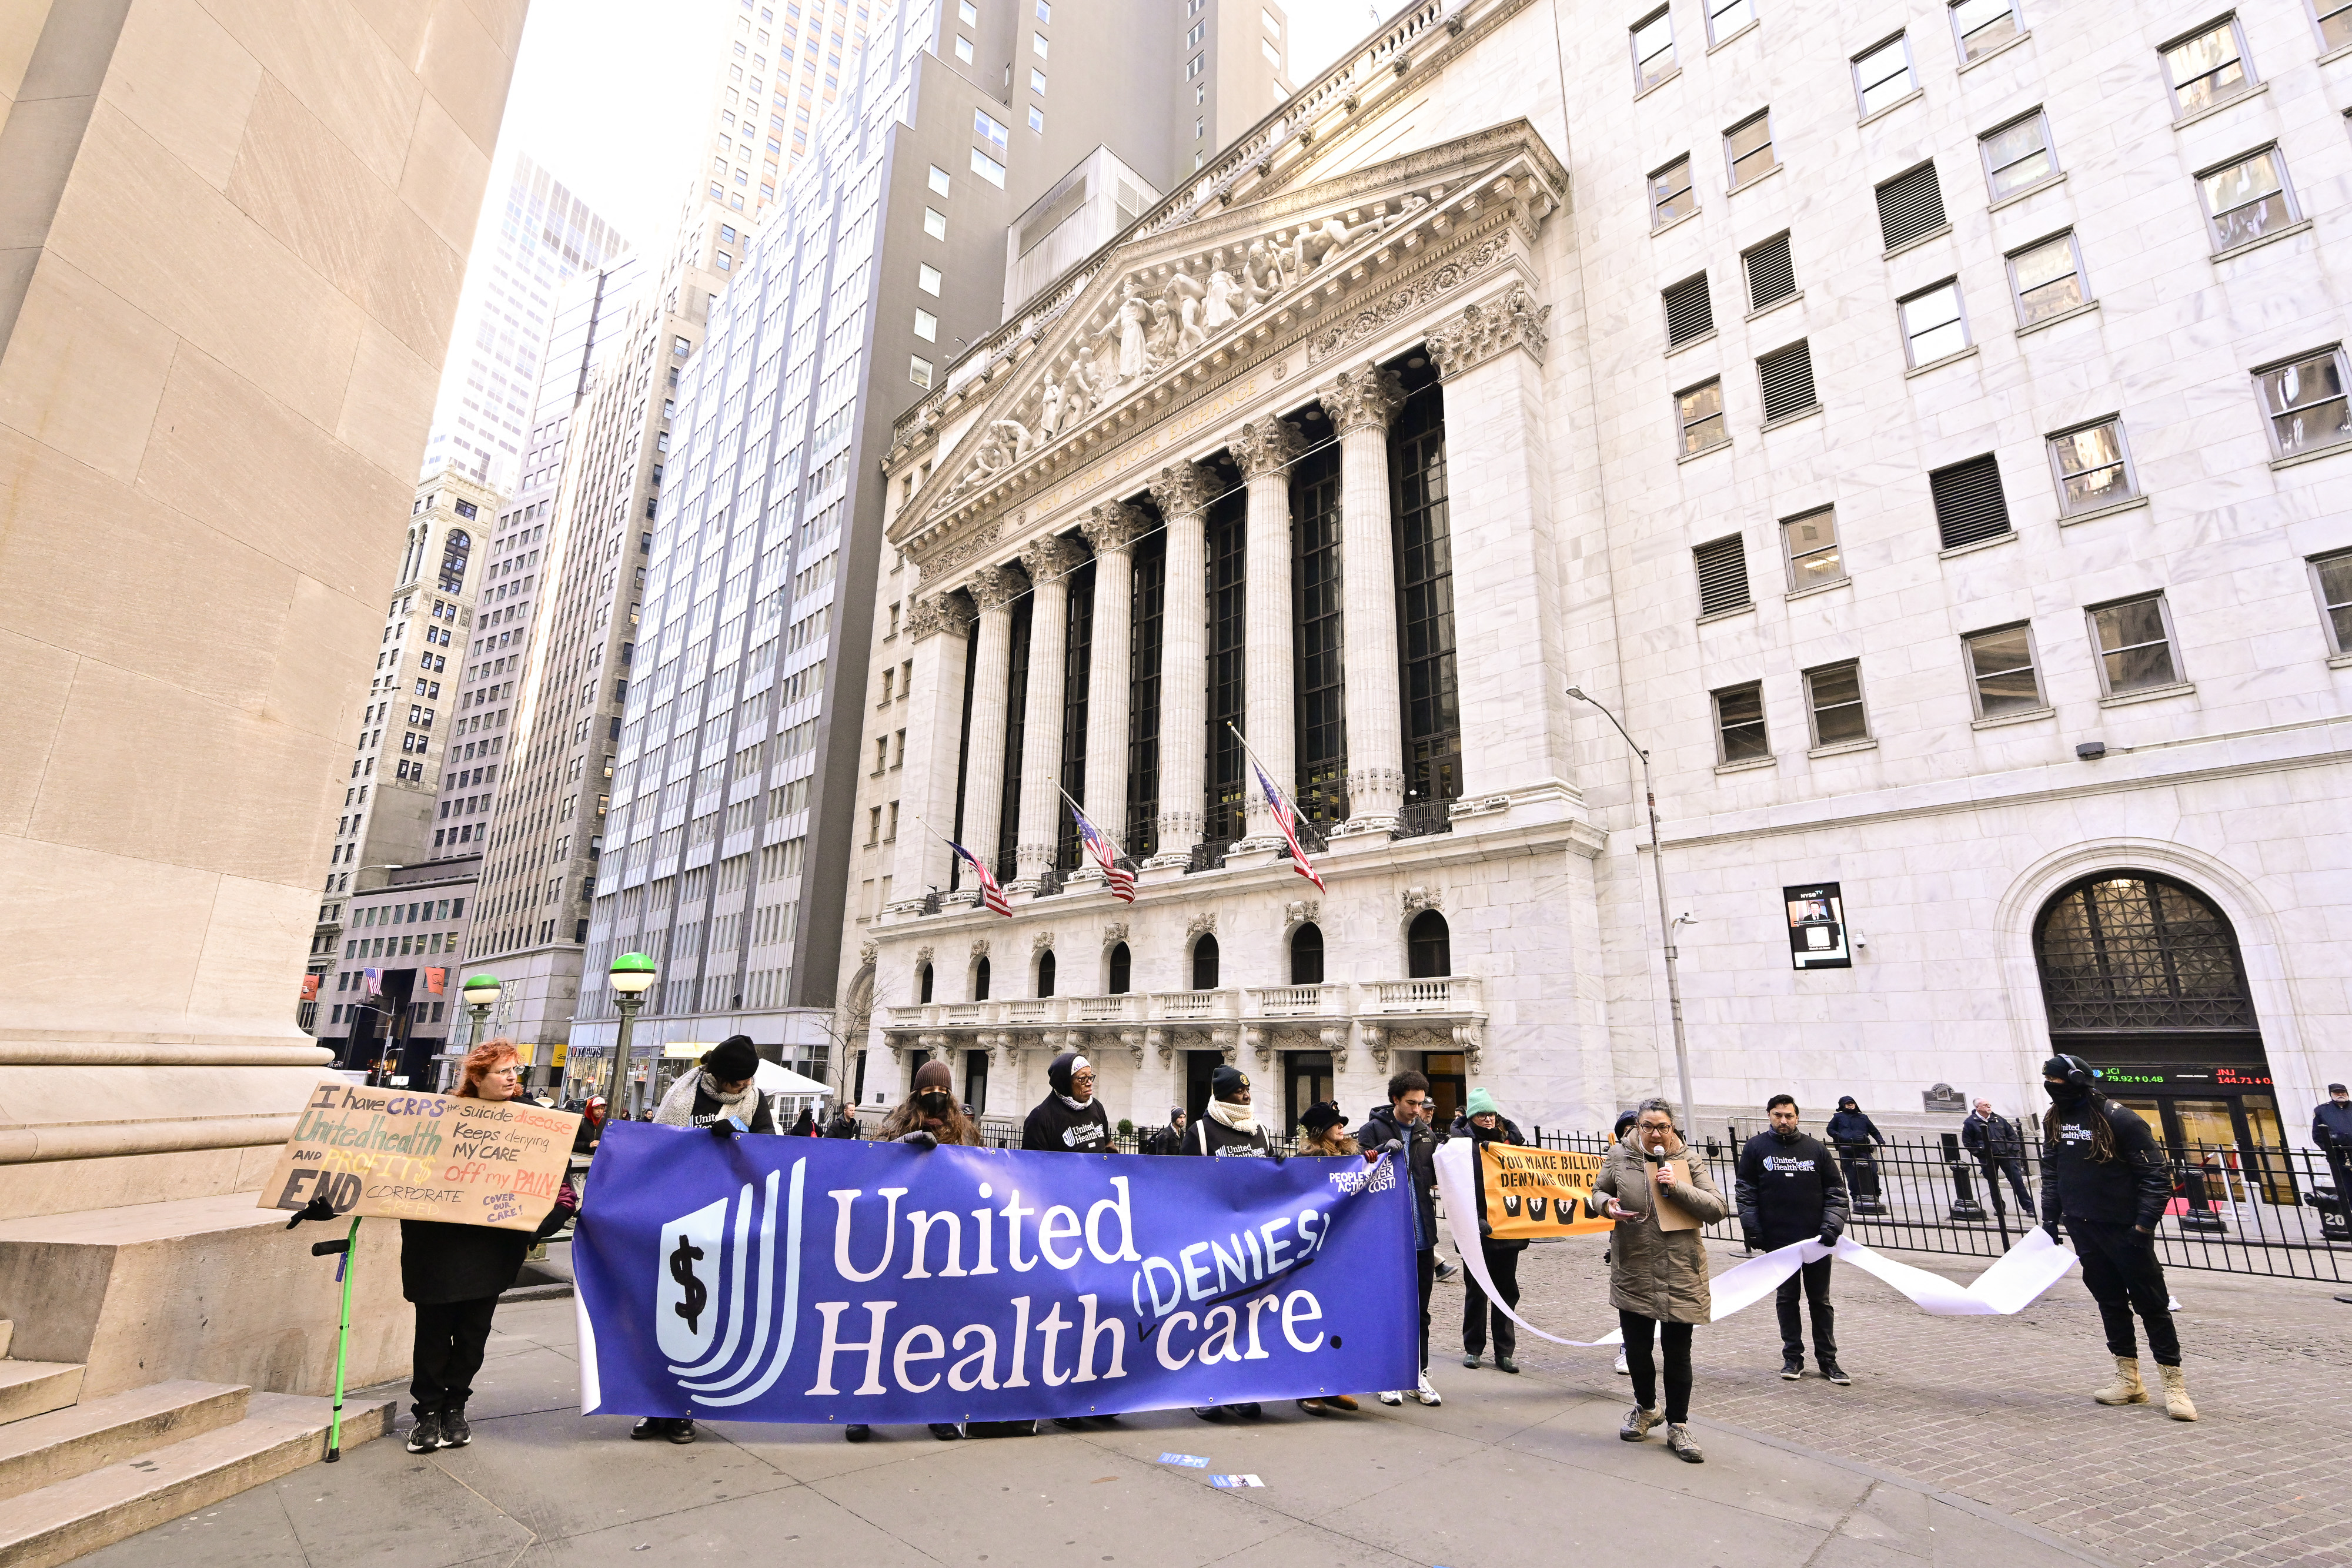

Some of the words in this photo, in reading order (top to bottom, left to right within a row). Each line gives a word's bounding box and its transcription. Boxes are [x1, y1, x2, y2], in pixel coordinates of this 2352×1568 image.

[1036, 489, 1063, 516] NEW
[1070, 464, 1106, 496] YORK
[1114, 434, 1160, 470] STOCK
[1170, 378, 1258, 441] EXCHANGE
[585, 1047, 602, 1058] GIFTS
[311, 1086, 340, 1109] I
[342, 1087, 386, 1111] have
[386, 1097, 447, 1118] CRPS
[445, 1104, 460, 1113] the
[460, 1105, 514, 1122] suicide
[514, 1109, 573, 1135] disease
[294, 1111, 442, 1156] Unitedhealth
[452, 1122, 500, 1145] Keeps
[505, 1129, 550, 1152] denying
[1072, 1121, 1095, 1135] United
[1075, 1131, 1097, 1144] Health
[452, 1142, 479, 1160] MY
[479, 1146, 521, 1162] CARE
[1227, 1144, 1252, 1153] United
[292, 1150, 322, 1161] AND
[320, 1148, 436, 1186] PROFIT$
[1497, 1156, 1524, 1170] YOU
[1525, 1156, 1557, 1169] MAKE
[485, 1173, 511, 1189] my
[513, 1169, 557, 1196] PAIN
[1368, 1176, 1396, 1193] COST!
[1501, 1173, 1556, 1187] DENYING
[1558, 1174, 1581, 1188] OUR
[276, 1168, 362, 1213] END
[366, 1185, 465, 1203] CORPORATE
[483, 1193, 516, 1205] COVER
[377, 1199, 439, 1215] GREED
[493, 1202, 511, 1211] OUR
[2324, 1212, 2345, 1226] 20
[827, 1176, 1142, 1282] United
[1132, 1209, 1331, 1319] (DENIES)
[804, 1293, 1128, 1396] Health
